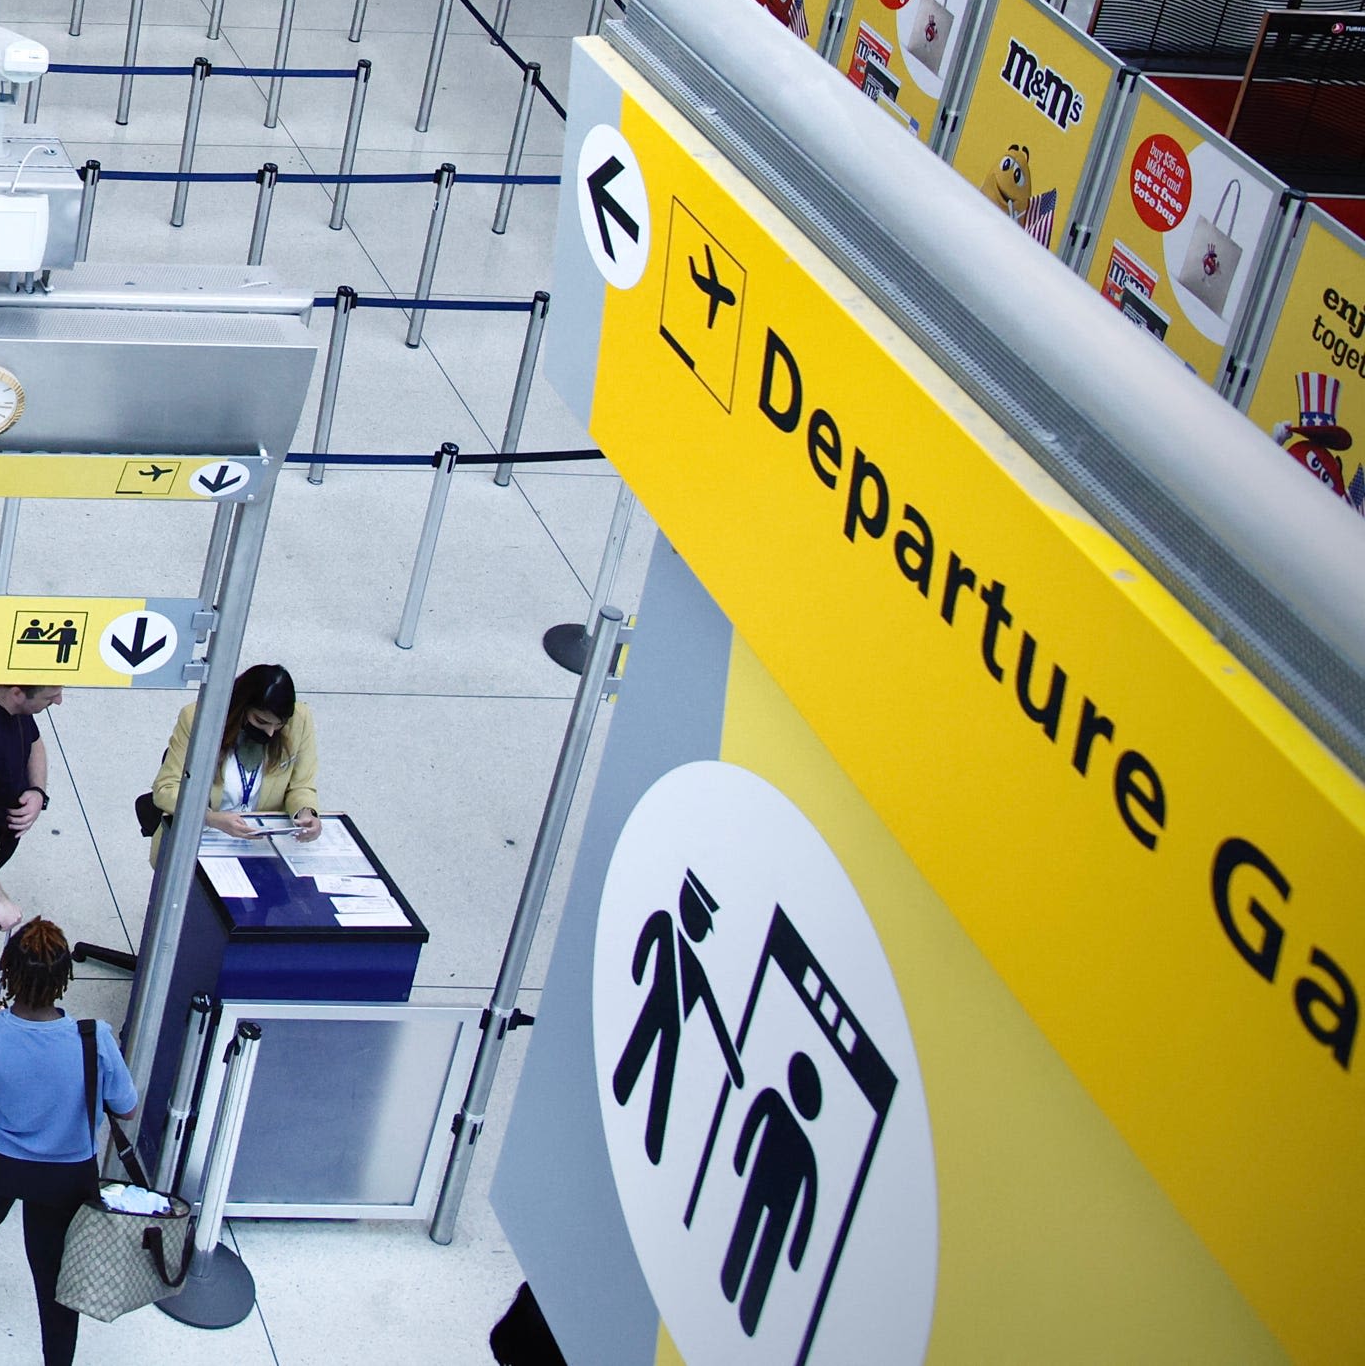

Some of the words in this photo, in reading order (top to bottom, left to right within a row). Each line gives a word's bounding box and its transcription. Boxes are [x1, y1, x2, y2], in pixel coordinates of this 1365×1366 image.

[1145, 158, 1167, 182] M&M's
[1166, 173, 1182, 195] and
[1149, 141, 1164, 161] buy
[1164, 153, 1177, 171] $35
[1175, 164, 1184, 180] on
[1133, 168, 1153, 191] get
[1153, 183, 1160, 193] a
[1159, 185, 1183, 213] free
[1133, 183, 1156, 208] tote
[1157, 199, 1177, 227] bag
[758, 326, 1167, 852] Departure
